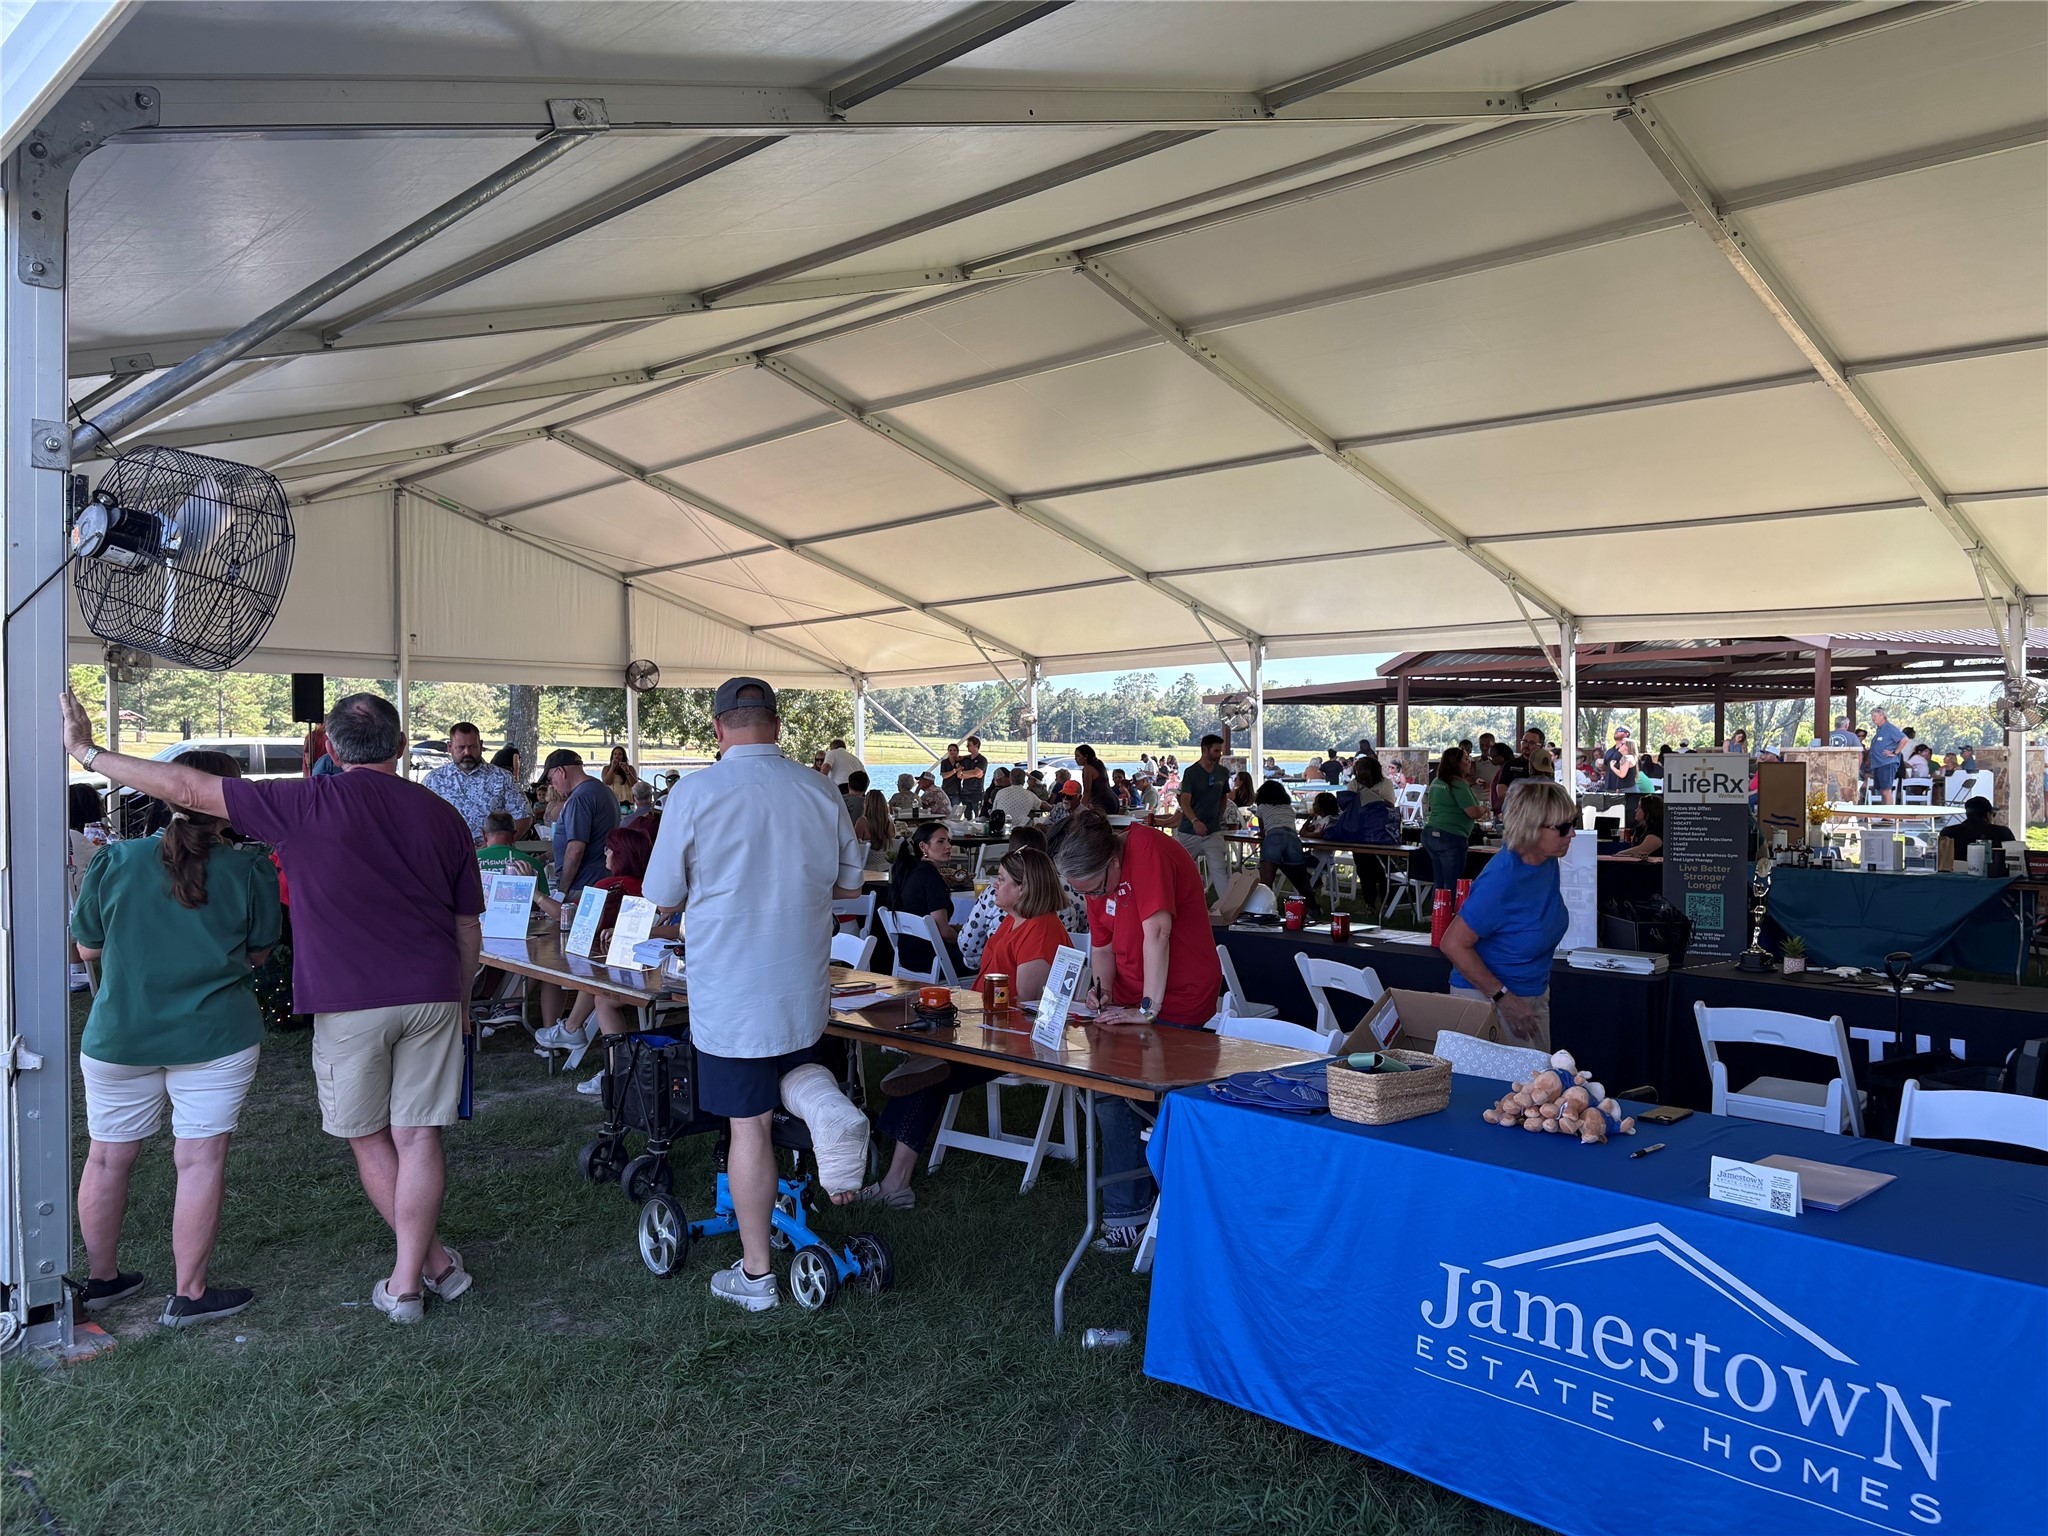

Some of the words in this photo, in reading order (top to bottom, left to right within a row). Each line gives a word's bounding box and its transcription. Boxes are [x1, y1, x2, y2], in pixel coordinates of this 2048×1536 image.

[1667, 773, 1744, 793] LifeRx
[1679, 863, 1698, 872] Live
[1700, 864, 1731, 873] Better
[1683, 872, 1726, 883] Stronger
[1687, 881, 1722, 891] Longer
[1416, 1334, 1615, 1421] ESTATE
[1703, 1426, 1942, 1525] HOMES
